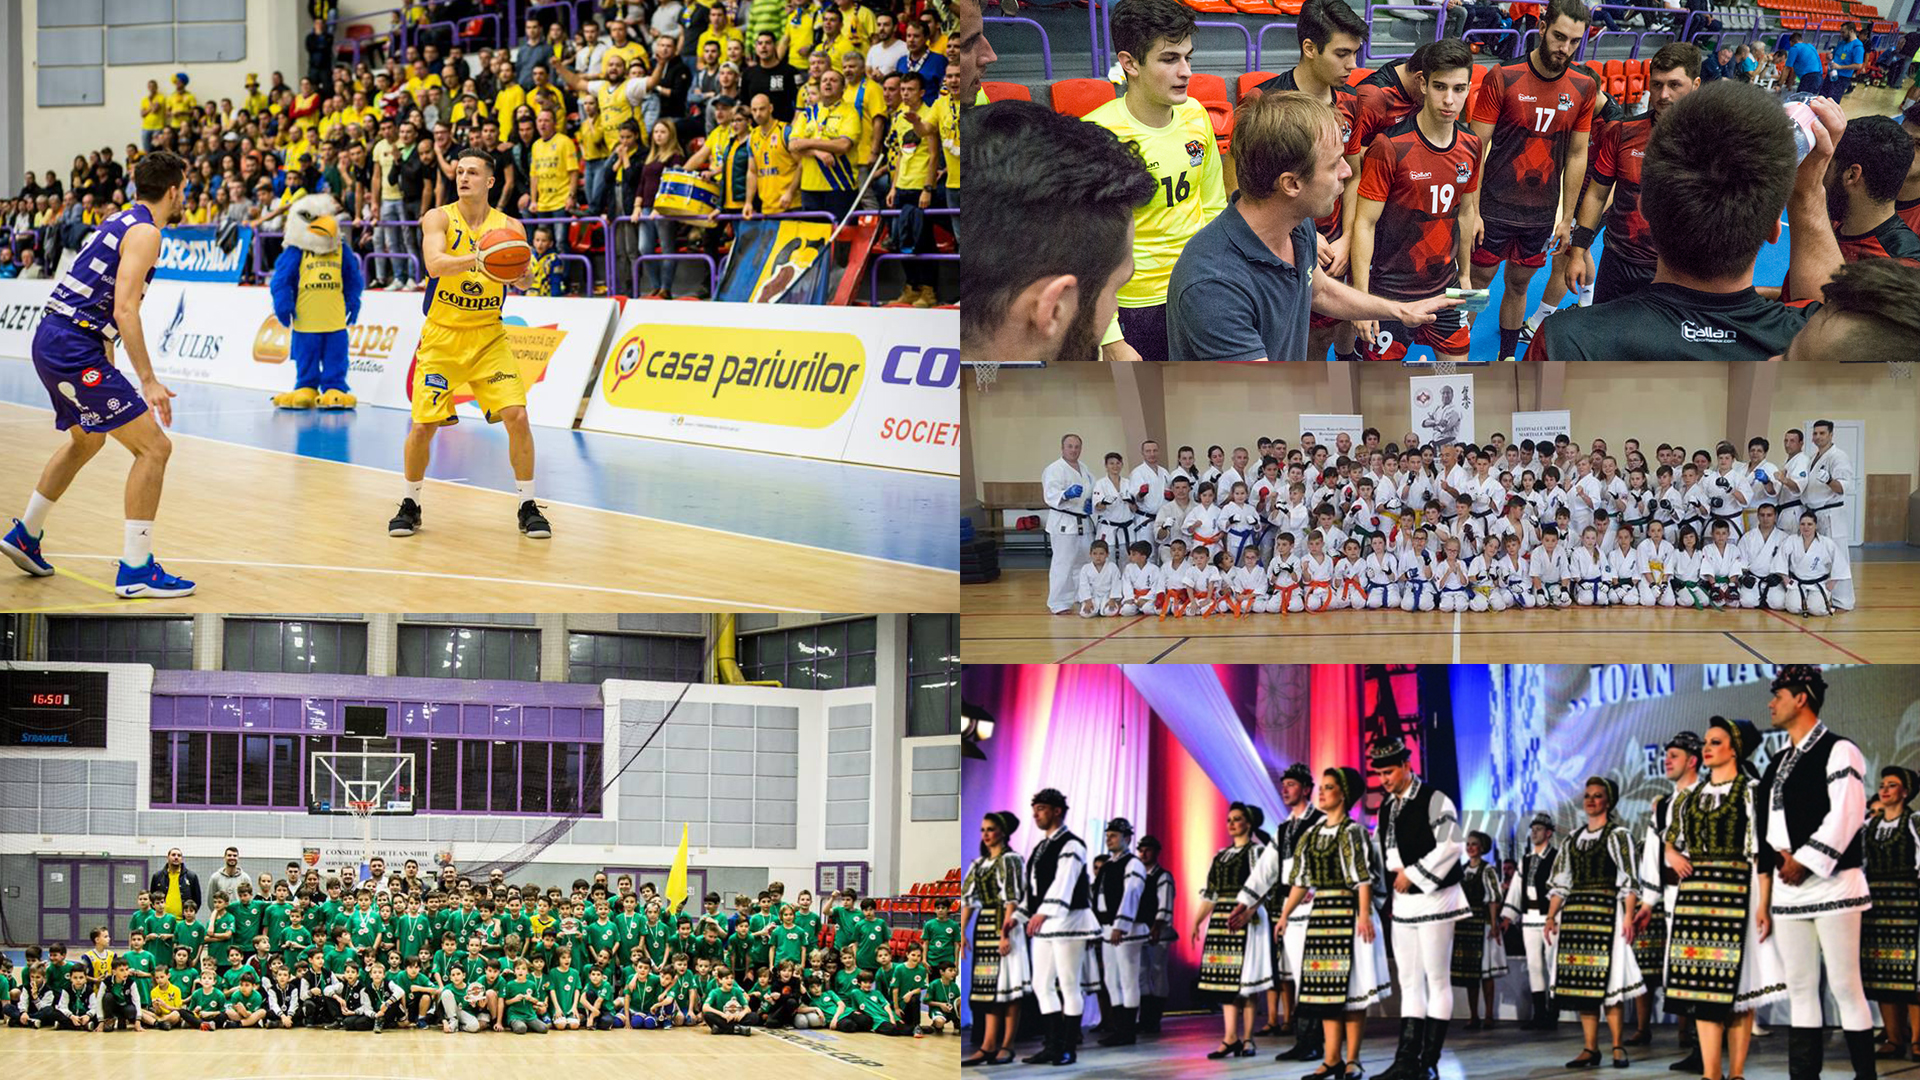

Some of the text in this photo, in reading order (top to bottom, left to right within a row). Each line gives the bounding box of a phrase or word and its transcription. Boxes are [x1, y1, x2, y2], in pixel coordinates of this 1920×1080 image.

[1534, 107, 1556, 133] 17
[1160, 171, 1191, 208] 16
[1430, 183, 1455, 214] 19
[451, 229, 462, 250] 7
[438, 290, 500, 311] compa
[178, 333, 224, 360] ULBS
[646, 349, 860, 399] casa pariurilor
[881, 345, 960, 389] CO
[432, 390, 441, 405] 7
[880, 417, 960, 447] SOCIET
